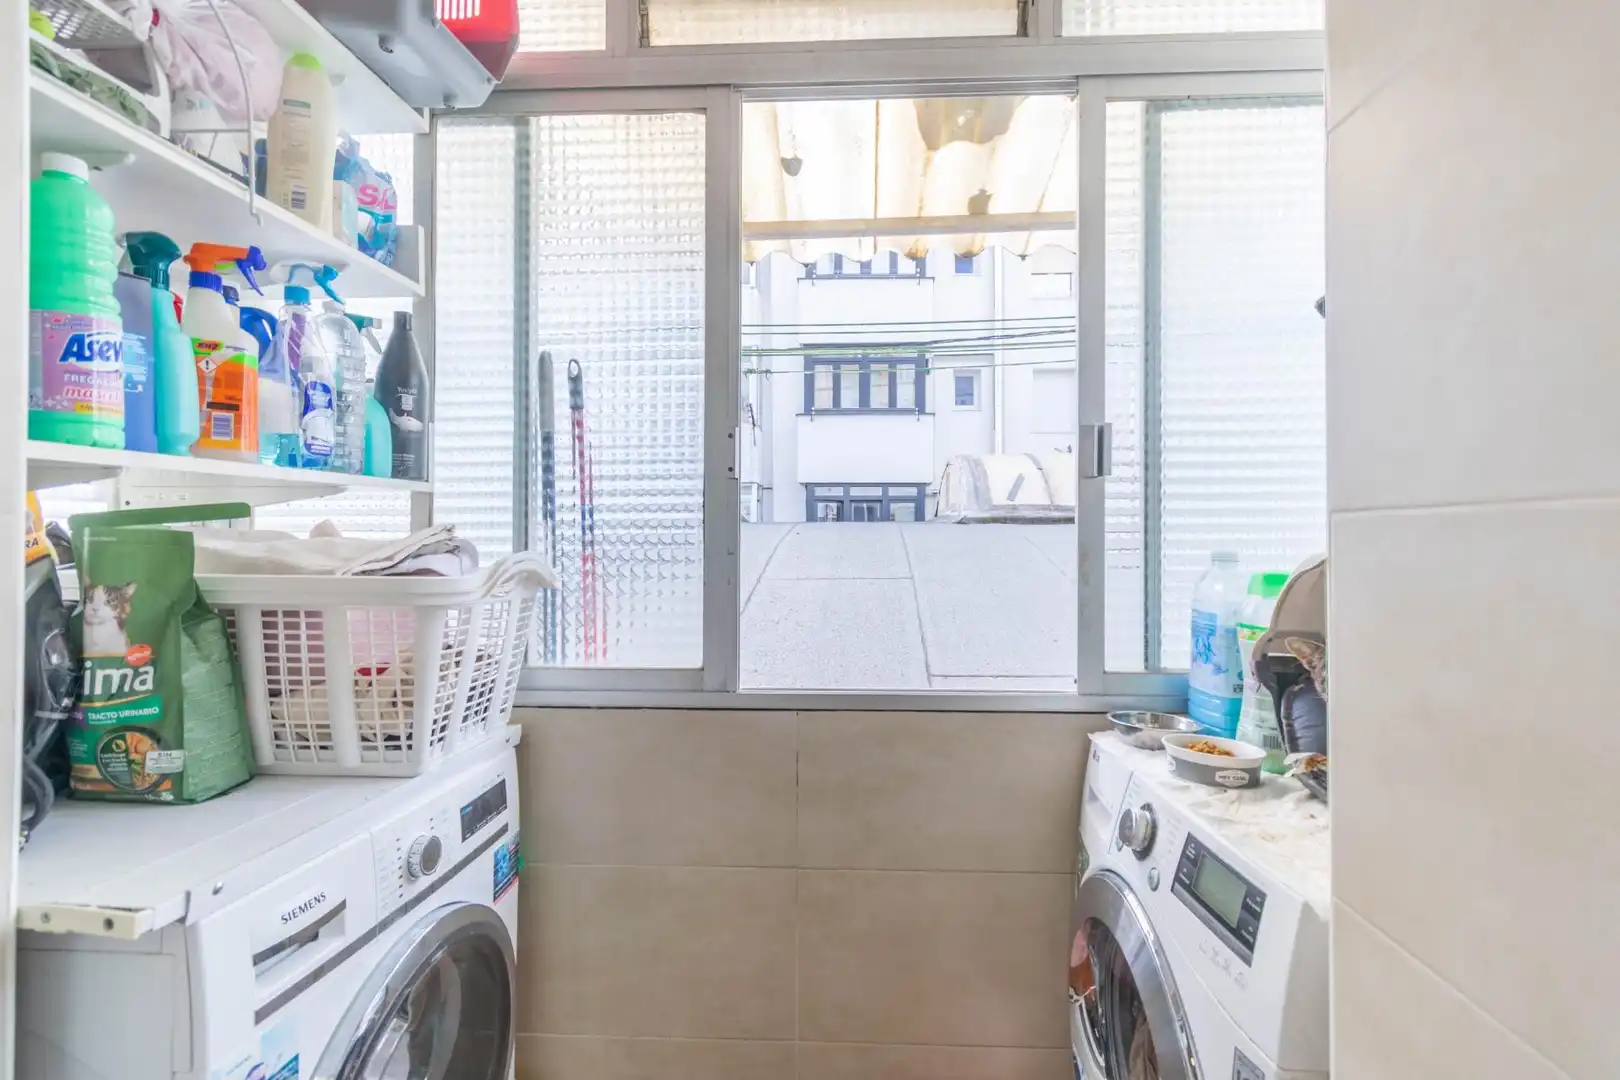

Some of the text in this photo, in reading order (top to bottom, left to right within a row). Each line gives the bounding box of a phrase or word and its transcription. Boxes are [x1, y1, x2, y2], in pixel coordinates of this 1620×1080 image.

[87, 712, 118, 720] TRACTO
[119, 706, 159, 718] URINARIO
[281, 891, 326, 925] SIEMENS
